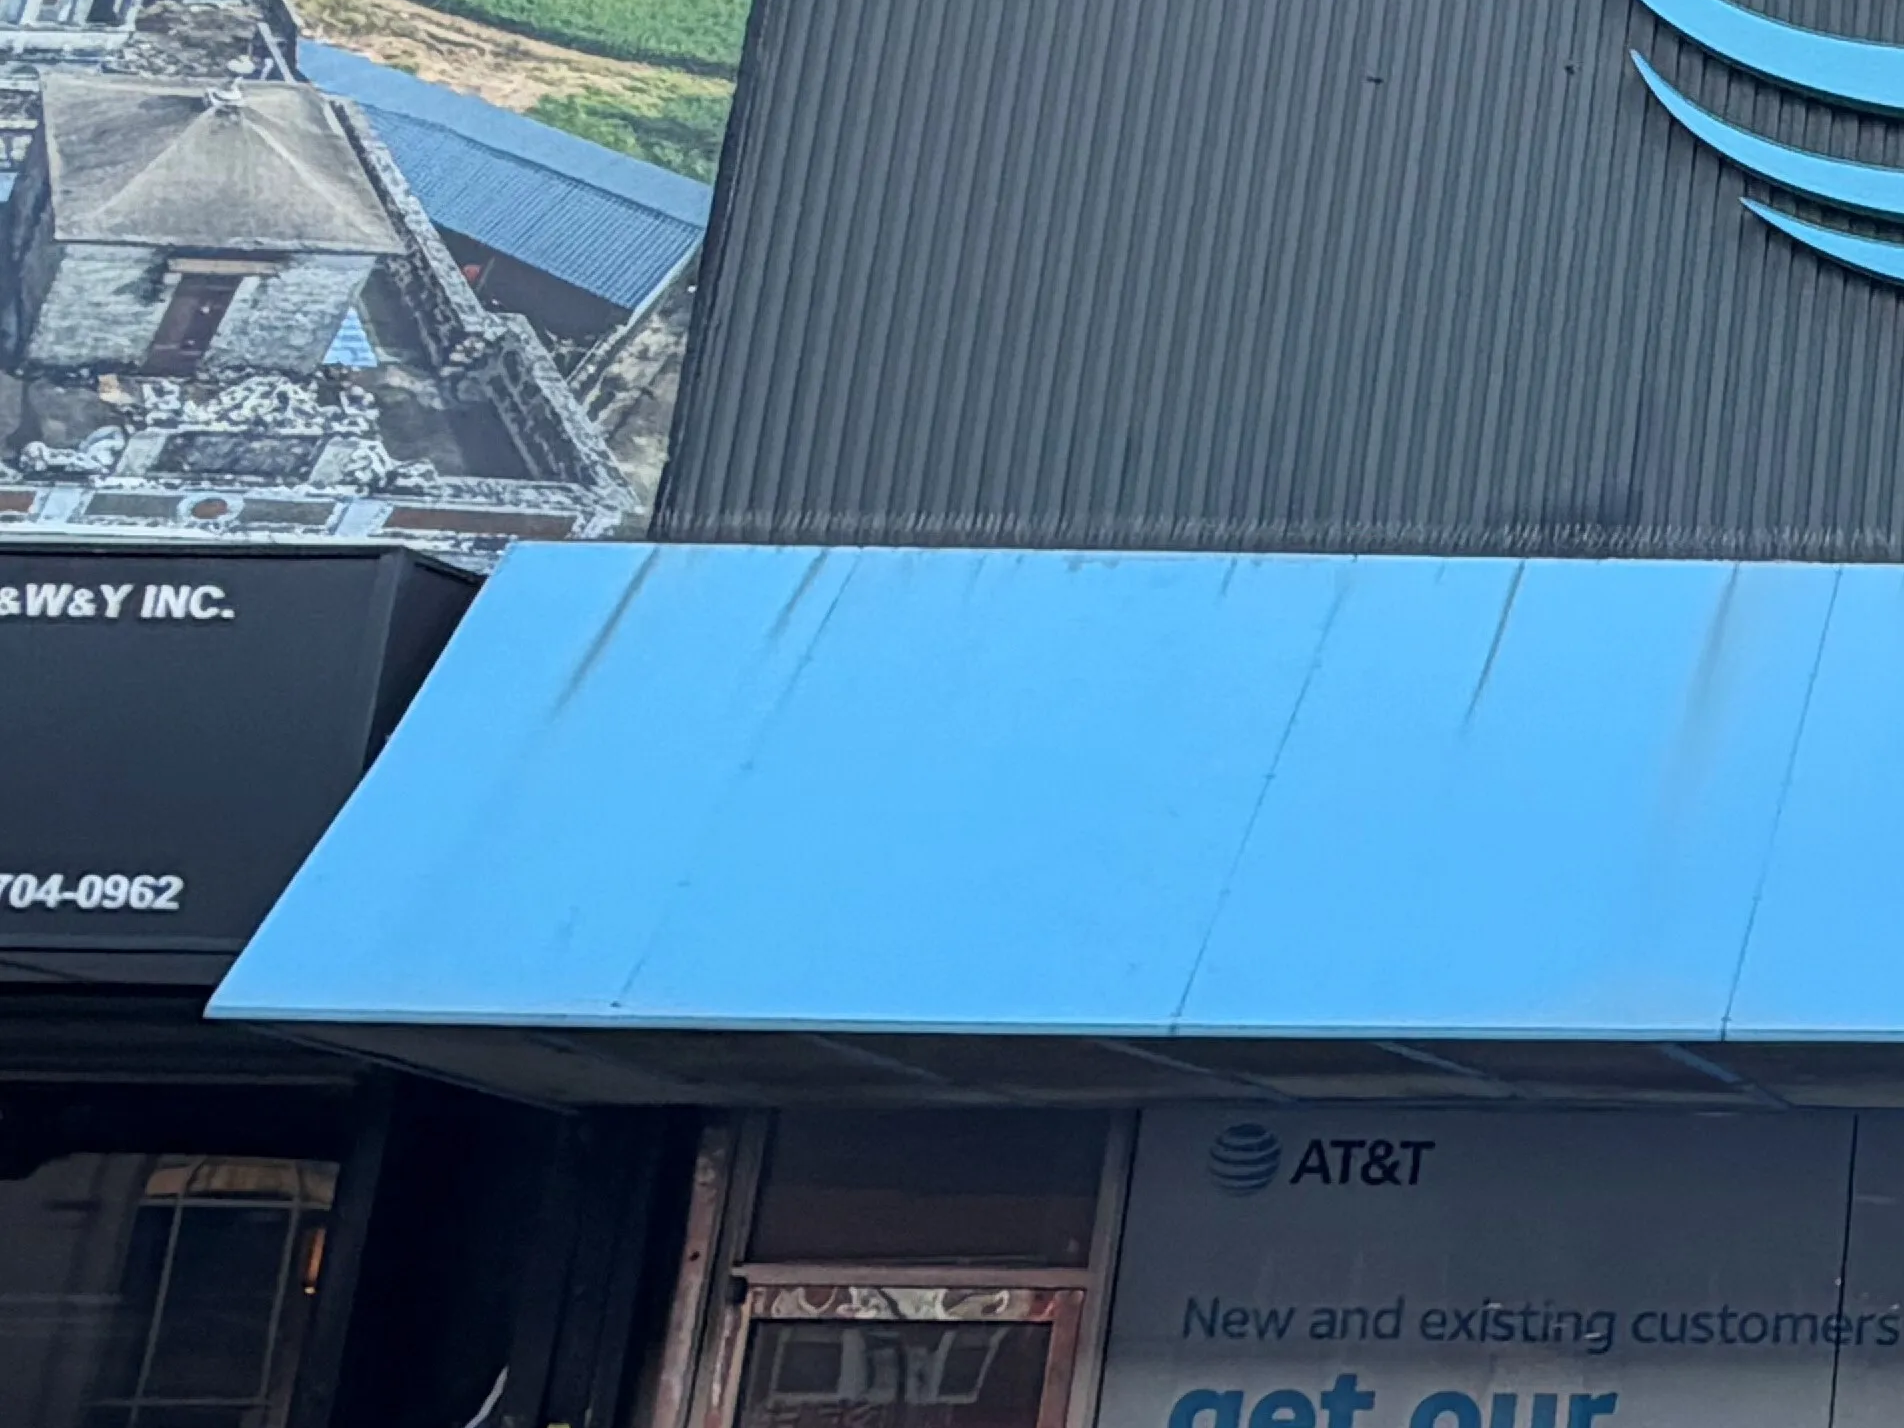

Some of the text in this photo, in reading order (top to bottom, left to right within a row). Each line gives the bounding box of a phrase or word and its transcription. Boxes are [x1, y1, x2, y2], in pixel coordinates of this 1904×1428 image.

[141, 584, 236, 620] INC.
[1289, 1138, 1436, 1186] AT&T
[1182, 1294, 1900, 1354] New and existing customers
